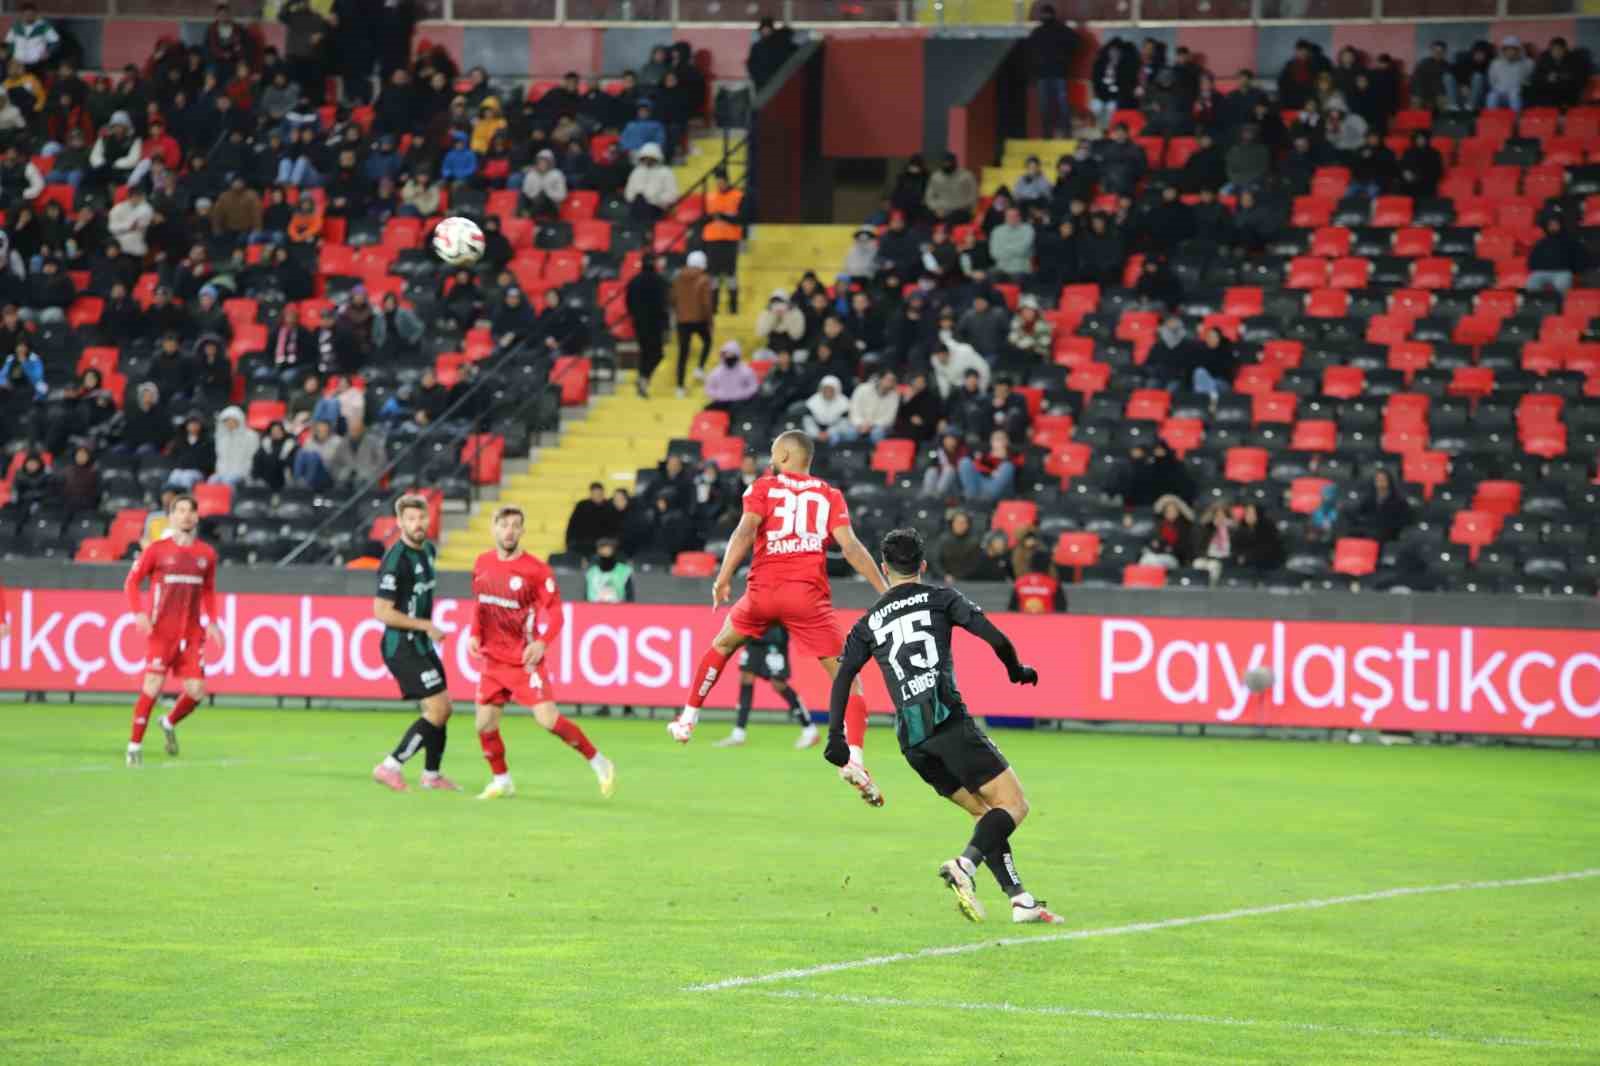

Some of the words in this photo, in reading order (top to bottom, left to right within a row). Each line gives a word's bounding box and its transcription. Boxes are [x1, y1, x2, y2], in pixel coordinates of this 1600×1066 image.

[766, 487, 831, 541] 30
[873, 592, 930, 622] AUTOPORT
[873, 610, 940, 681] 75
